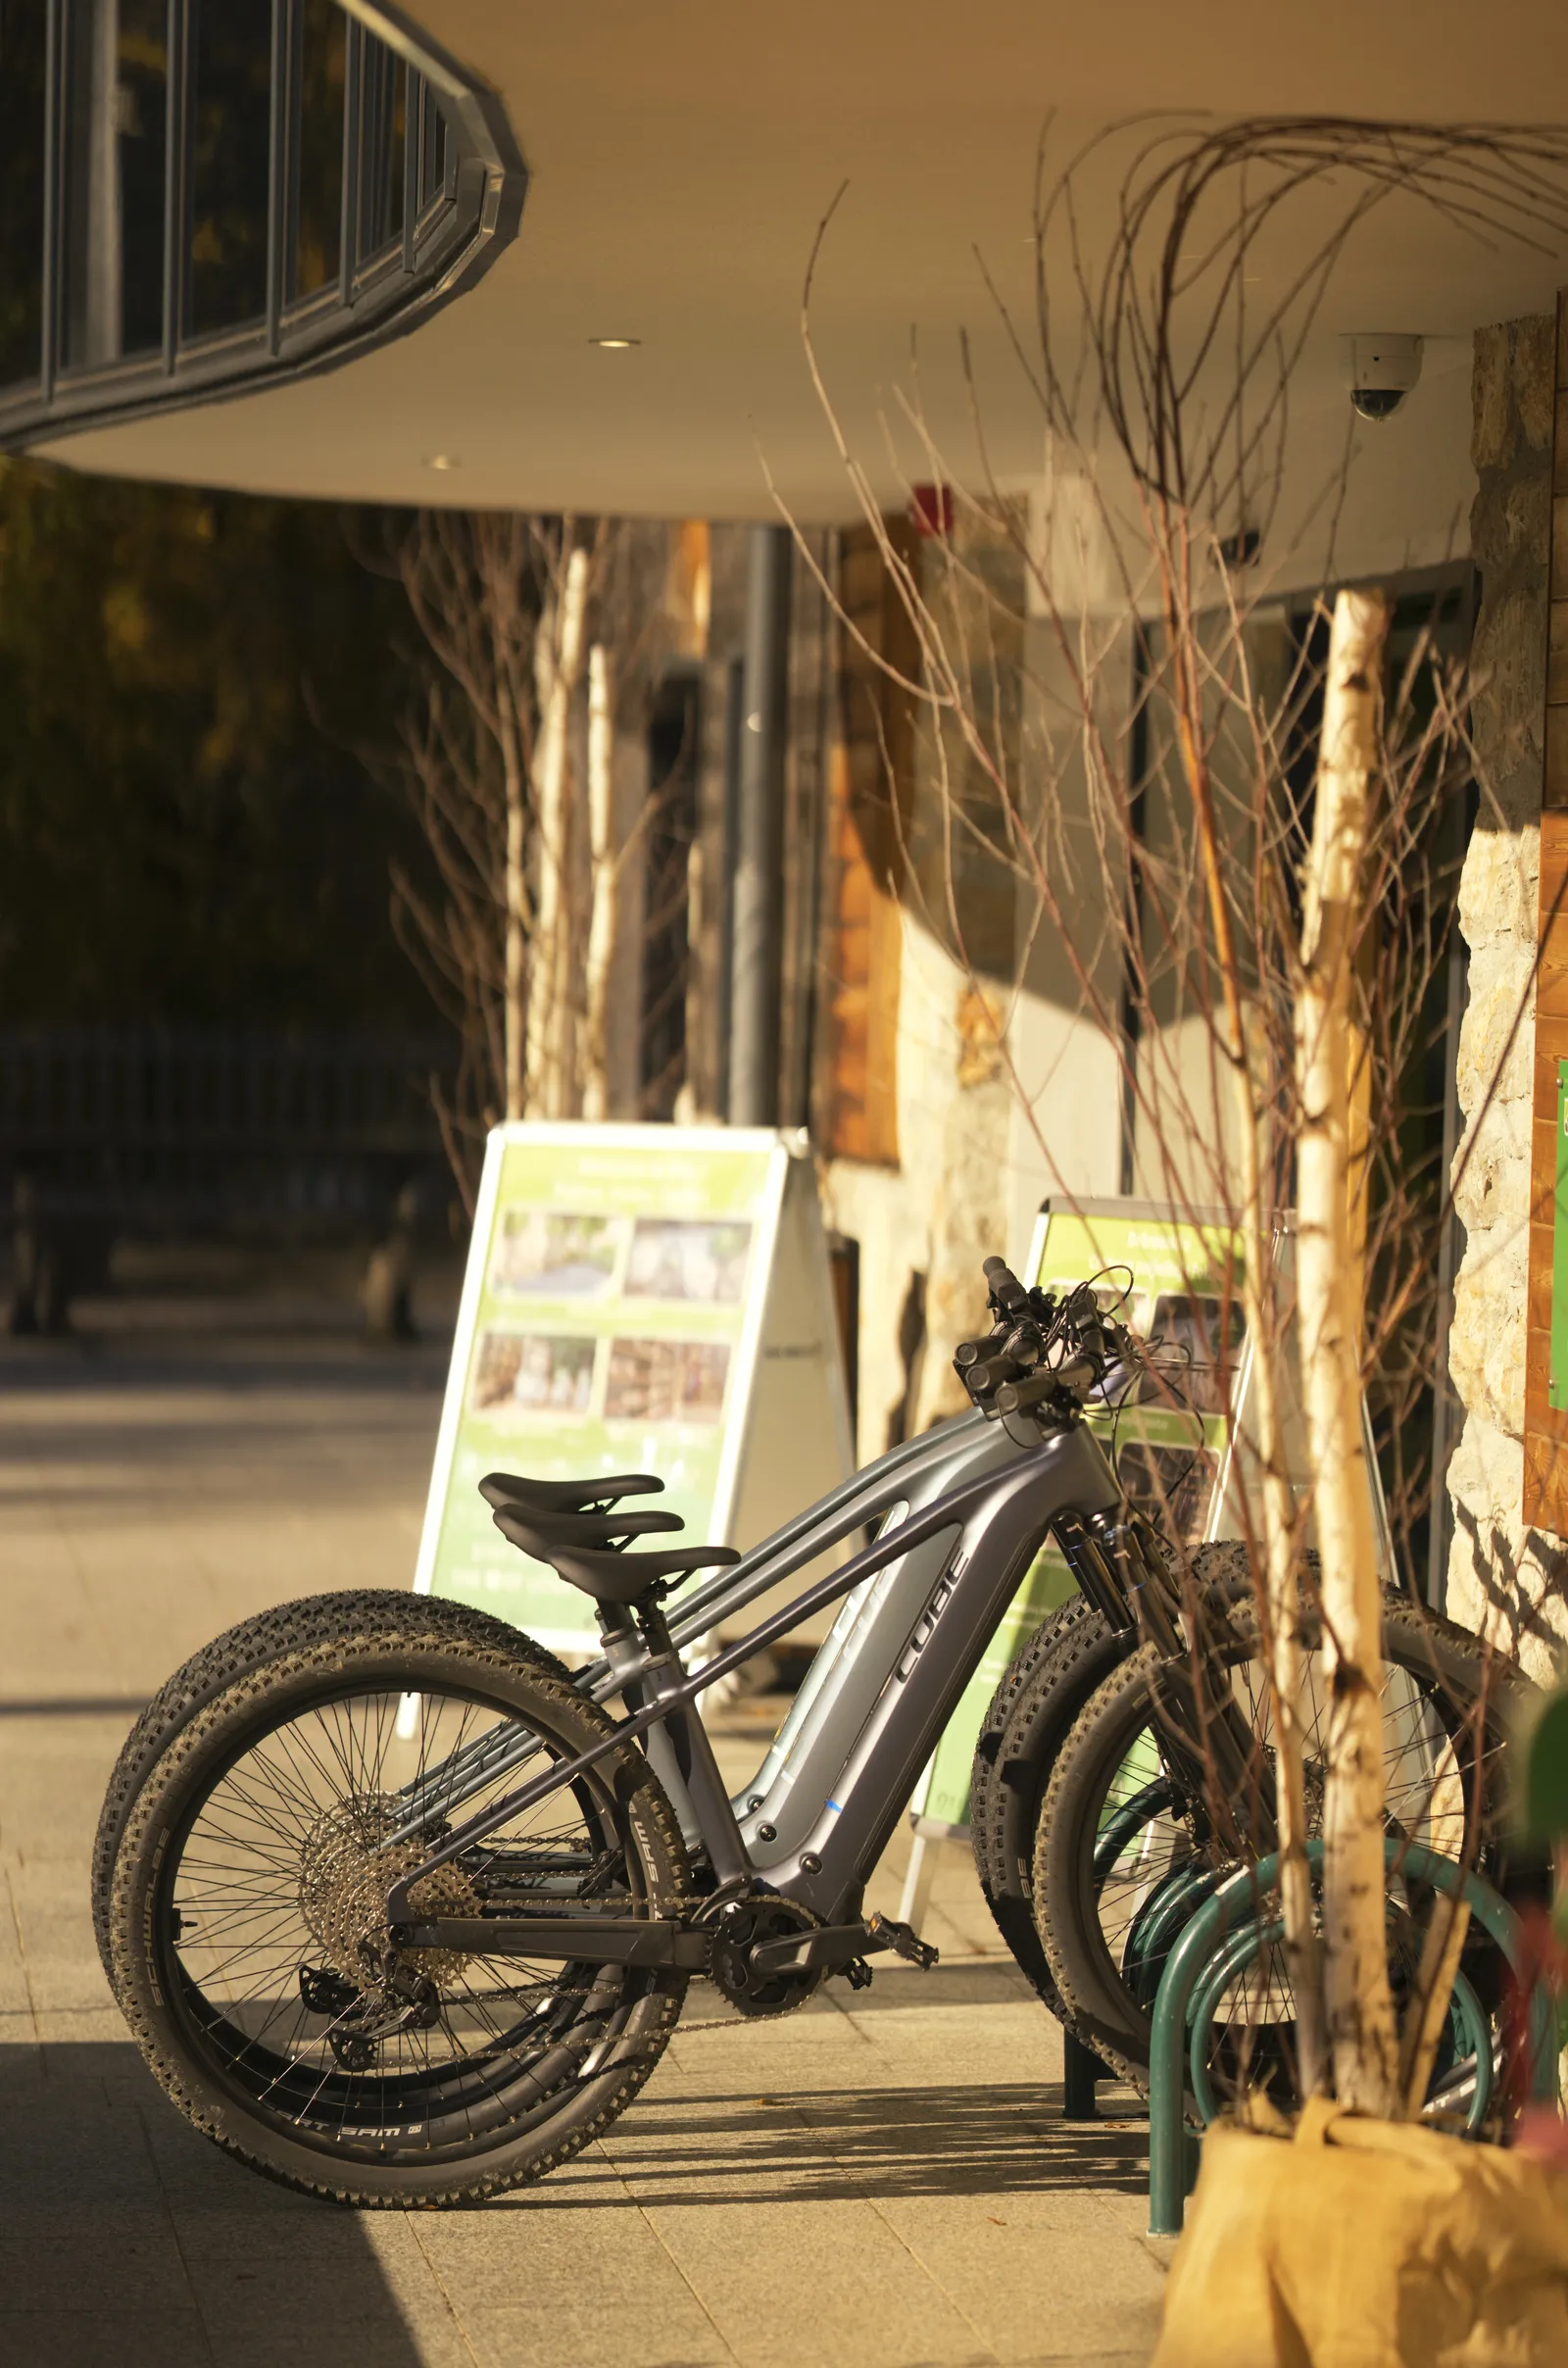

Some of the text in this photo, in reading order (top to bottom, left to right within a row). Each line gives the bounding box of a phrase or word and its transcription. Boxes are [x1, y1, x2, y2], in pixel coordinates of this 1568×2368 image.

[896, 1546, 969, 1684] CUBE
[634, 1821, 660, 1883] SAM
[143, 1827, 171, 2006] SCHWALBE
[337, 2126, 401, 2138] SAM
